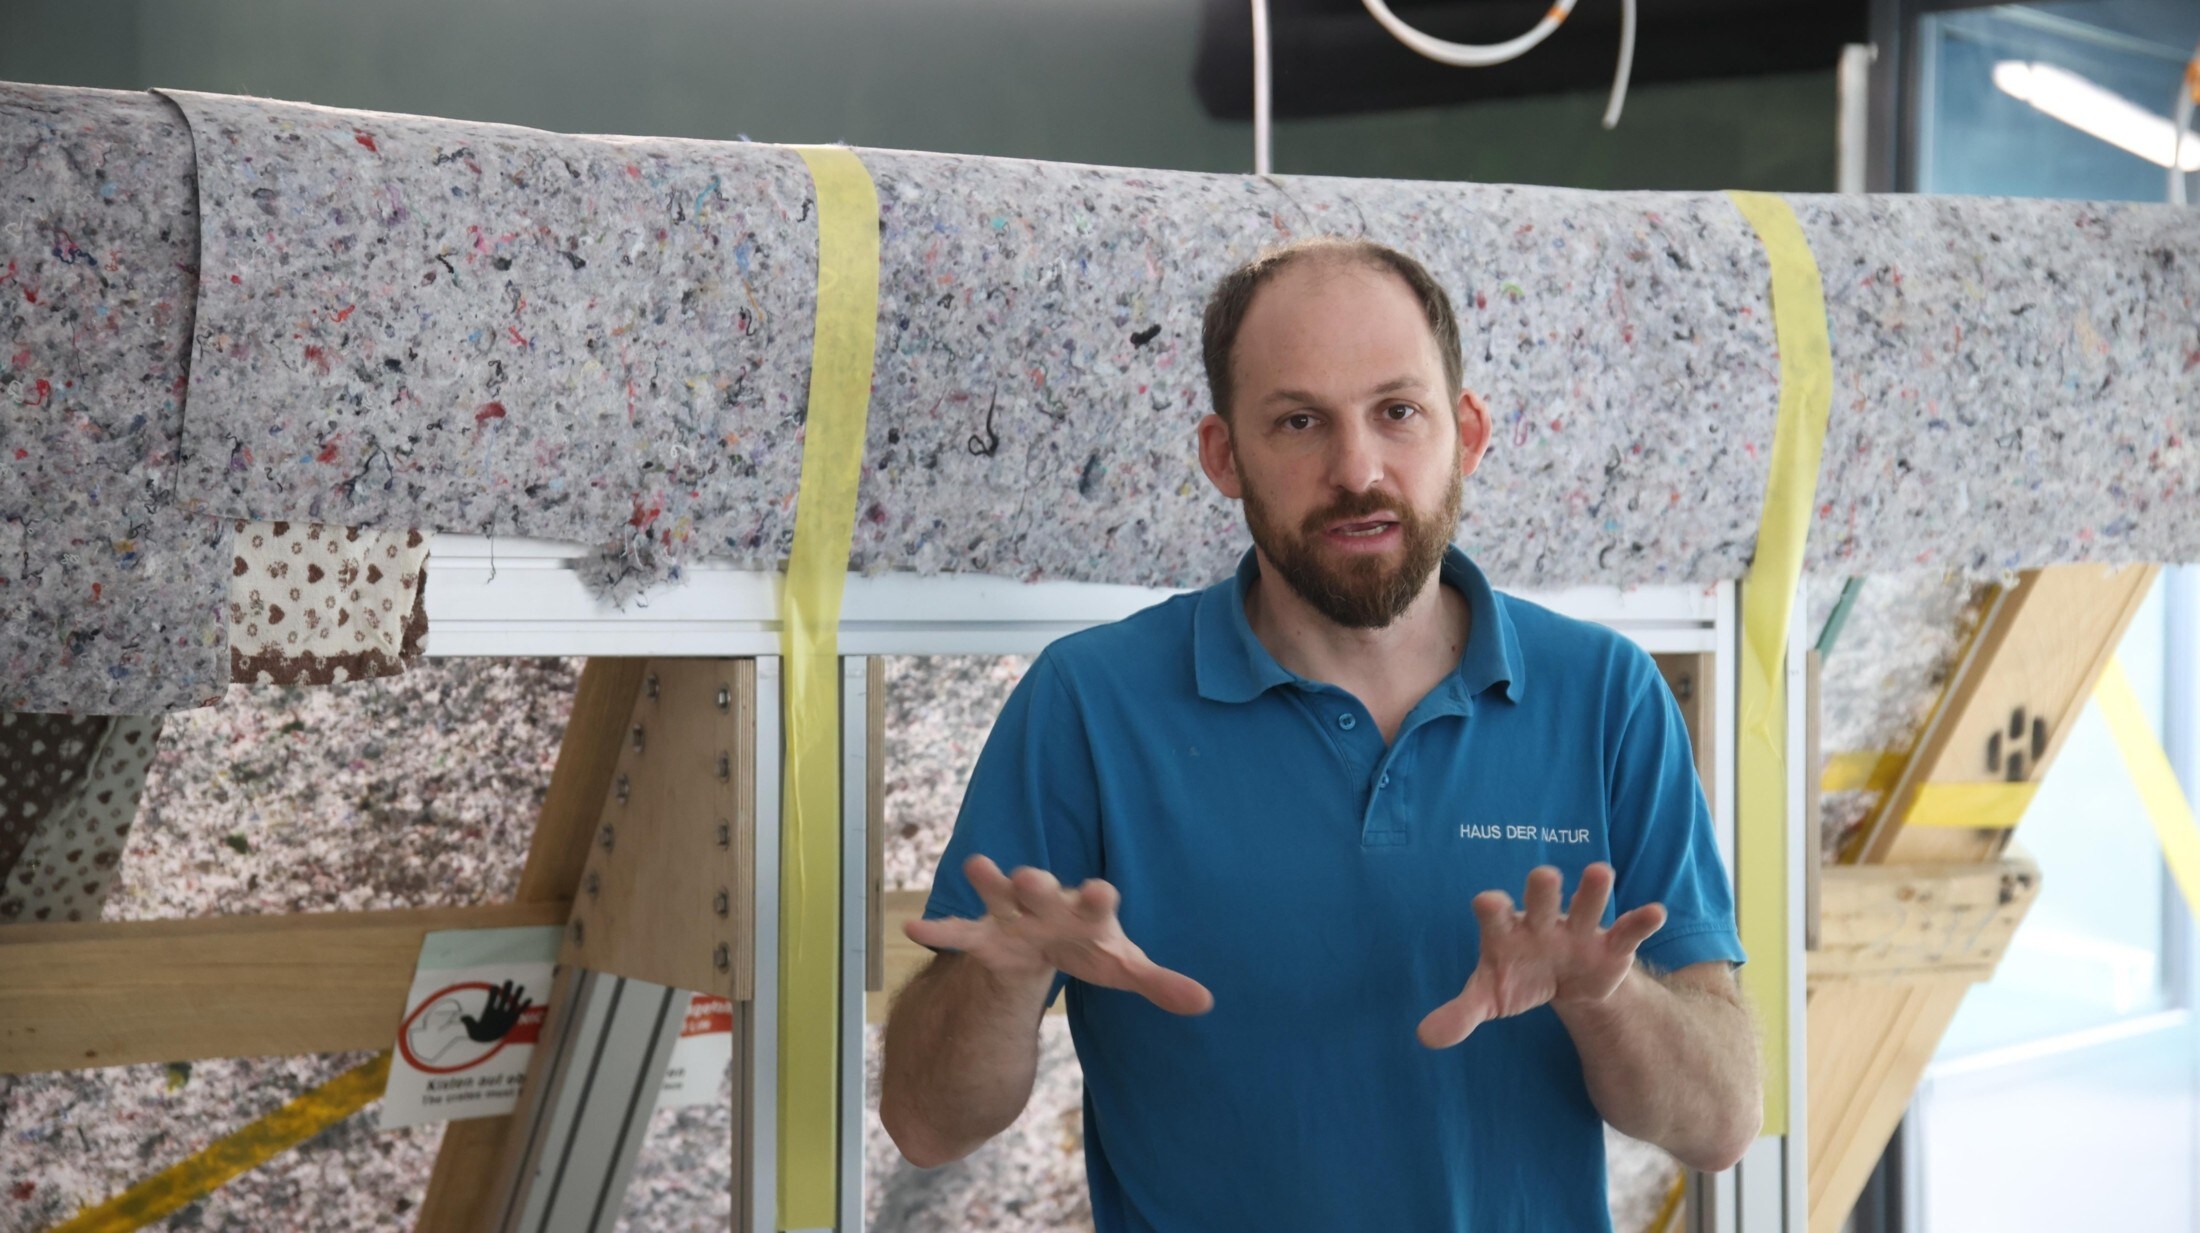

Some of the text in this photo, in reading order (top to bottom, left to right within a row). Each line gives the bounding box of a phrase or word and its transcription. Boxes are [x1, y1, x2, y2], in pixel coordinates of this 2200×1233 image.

[1459, 823, 1590, 844] HAUS DER NATUR
